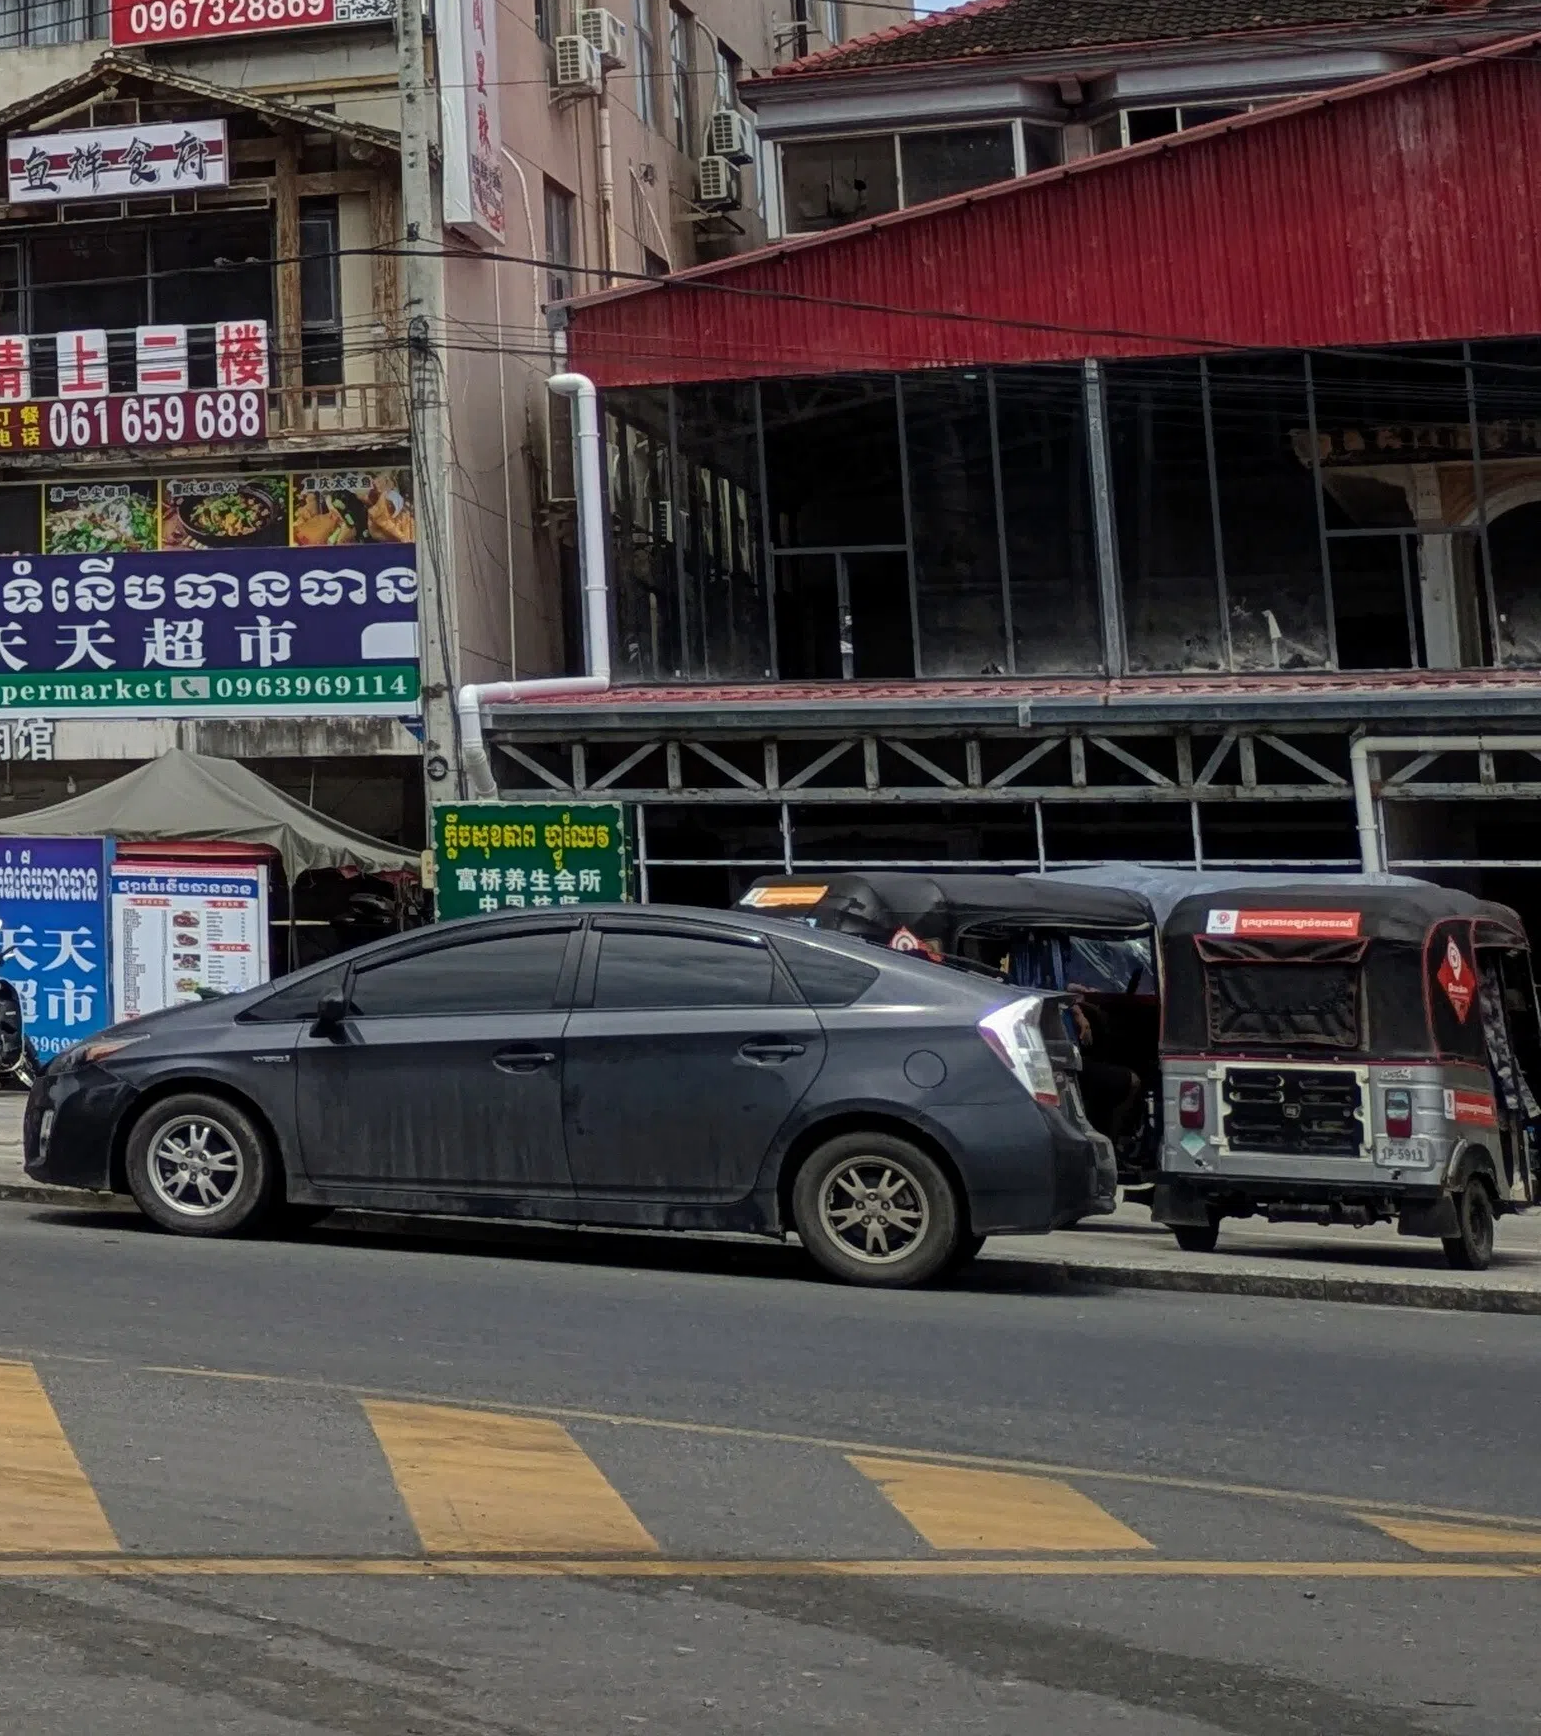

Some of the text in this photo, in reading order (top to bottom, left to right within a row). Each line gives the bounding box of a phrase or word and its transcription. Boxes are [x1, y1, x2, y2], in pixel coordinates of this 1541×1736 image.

[49, 391, 262, 448] 061 659 688
[216, 673, 409, 700] 0963969114
[455, 867, 603, 894] 富桥养生会所
